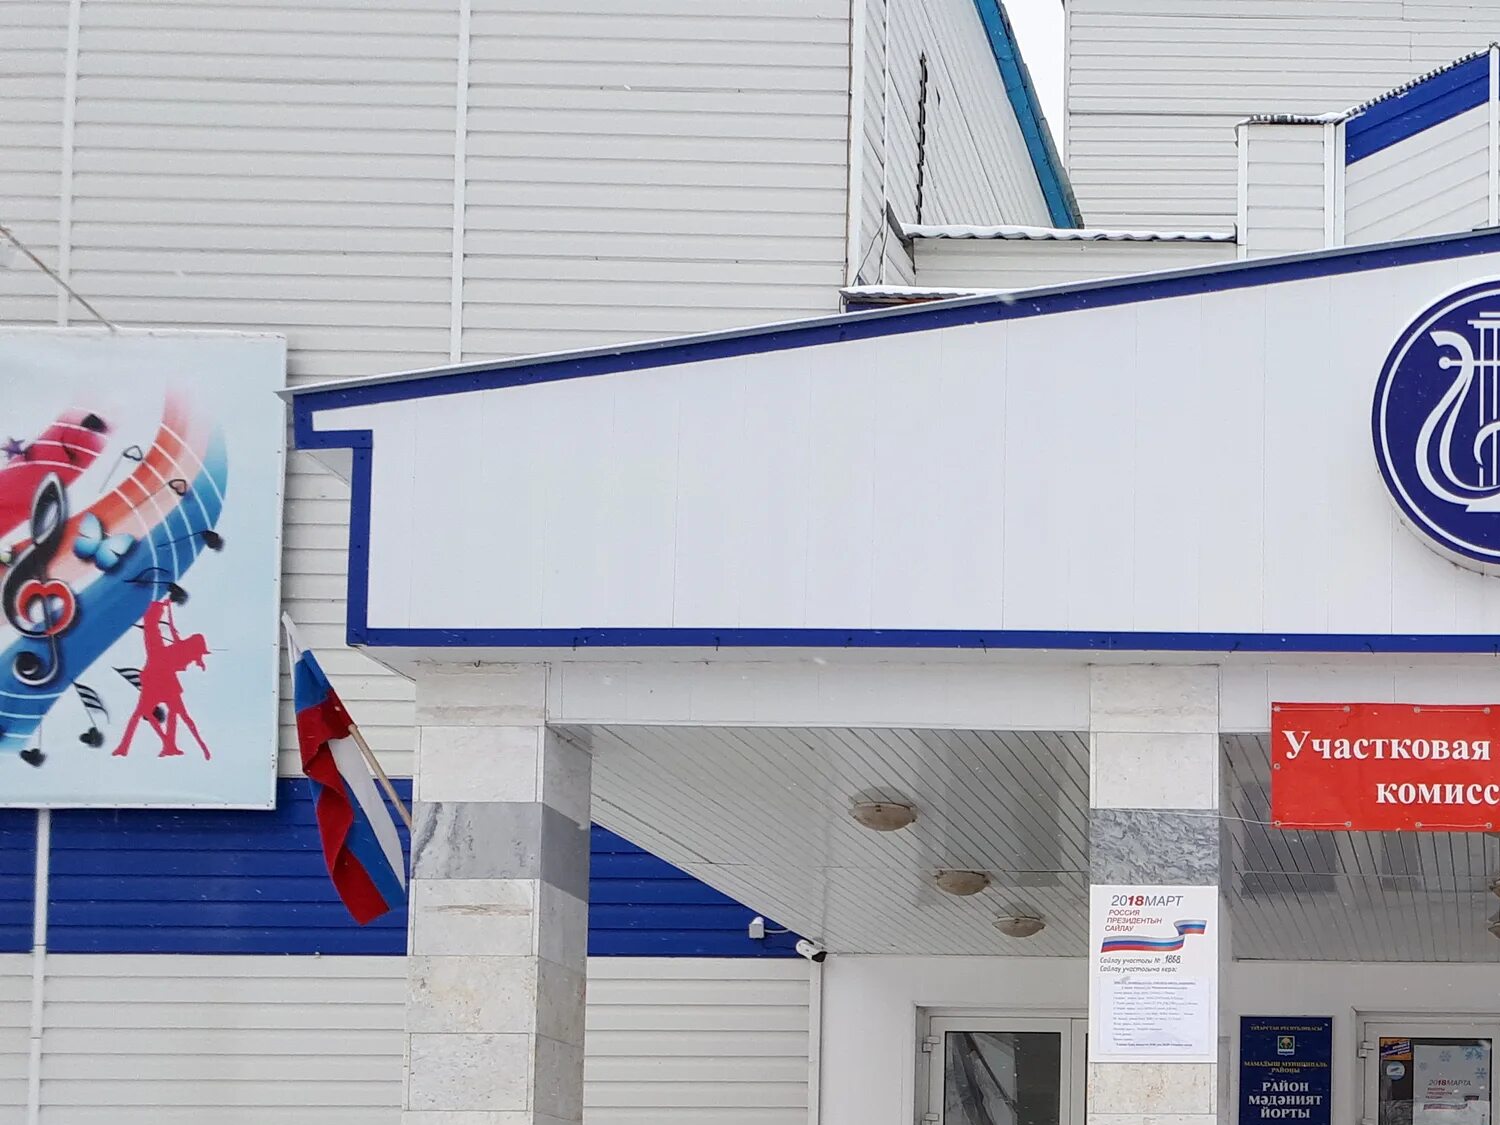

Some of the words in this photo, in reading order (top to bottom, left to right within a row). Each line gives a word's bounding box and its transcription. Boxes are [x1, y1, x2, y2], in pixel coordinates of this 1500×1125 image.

[1281, 729, 1491, 761] Участковая
[1106, 917, 1163, 925] ПРЕЗИДЕНТЫН
[1104, 924, 1134, 932] САЙЛАУ
[1262, 1080, 1309, 1092] РАЙОН
[1248, 1095, 1322, 1106] МӘДӘНИЯТ
[1260, 1107, 1311, 1119] ЙОРТЫ
